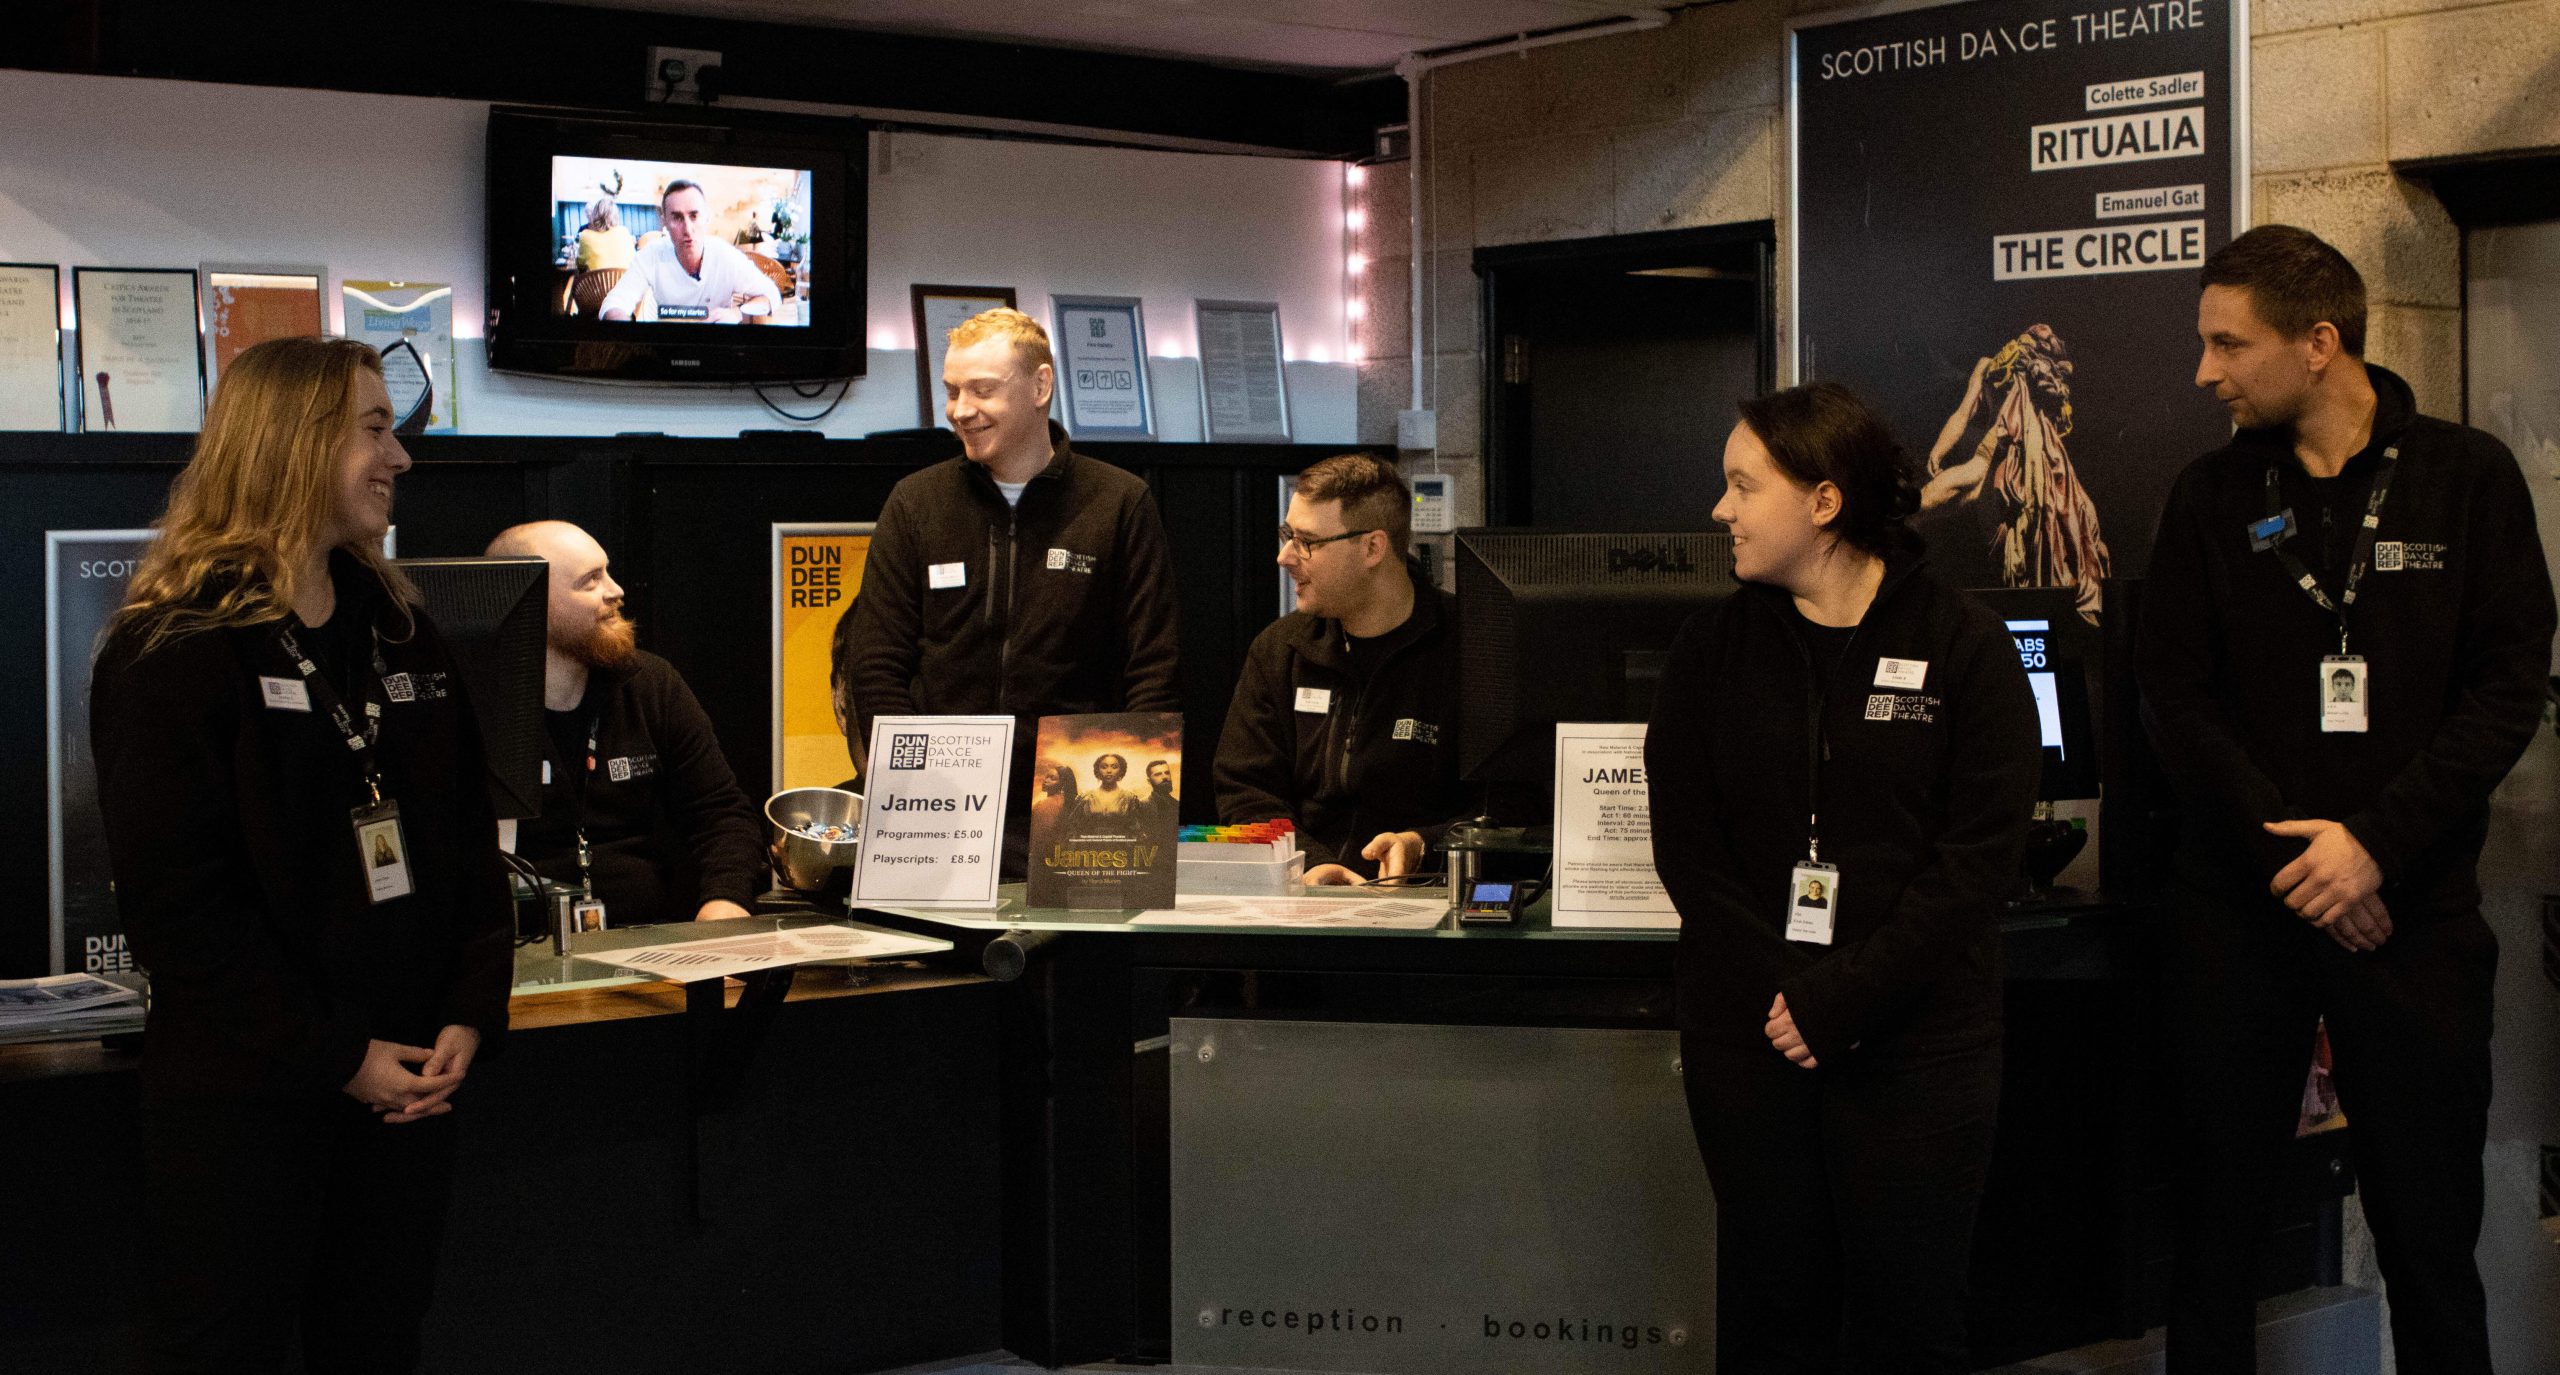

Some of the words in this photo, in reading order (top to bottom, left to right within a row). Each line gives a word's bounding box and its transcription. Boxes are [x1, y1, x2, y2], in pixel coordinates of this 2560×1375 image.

[1821, 36, 1946, 81] SCOTTISH
[2072, 0, 2205, 44] THEATRE
[2090, 83, 2145, 105] Colette
[2149, 77, 2199, 97] Sadler
[2037, 115, 2200, 164] RITUALIA
[2102, 193, 2168, 212] Emanuel
[2171, 190, 2200, 207] Gat
[1999, 237, 2064, 273] THE
[2075, 226, 2200, 268] CIRCLE
[2378, 544, 2401, 552] DUN
[2403, 543, 2447, 552] SCOTTISH
[791, 546, 841, 565] DUN
[1608, 546, 1694, 572] DELL
[2378, 552, 2400, 560] DEE
[80, 560, 142, 579] SCOT
[2378, 560, 2401, 568] REP
[2404, 560, 2444, 569] THEATRE
[791, 567, 841, 586] DEE
[791, 588, 841, 608] REP
[384, 676, 409, 685] DUN
[388, 684, 411, 692] DEE
[391, 691, 414, 700] REP
[1870, 696, 1893, 704] DUN
[1895, 695, 1941, 706] SCOTTISH
[1868, 703, 1891, 711] DEE
[1893, 711, 1934, 724] THEATRE
[894, 735, 927, 746] DUN
[930, 735, 992, 746] SCOTTISH
[893, 746, 925, 757] DEE
[892, 757, 924, 768] REP
[928, 758, 983, 768] THEATRE
[1593, 788, 1620, 796] Queen
[1622, 788, 1631, 796] of
[1633, 788, 1646, 796] the
[881, 794, 956, 812] James
[964, 794, 988, 812] IV
[876, 829, 950, 841] Programmes:
[953, 829, 983, 839] £5.00
[873, 854, 939, 866] Playscripts:
[950, 854, 980, 864] £8.50
[1044, 843, 1128, 868] James
[1132, 845, 1159, 868] IV
[86, 952, 134, 972] DEE
[1220, 1307, 1404, 1336] reception
[1483, 1314, 1663, 1351] bookings
